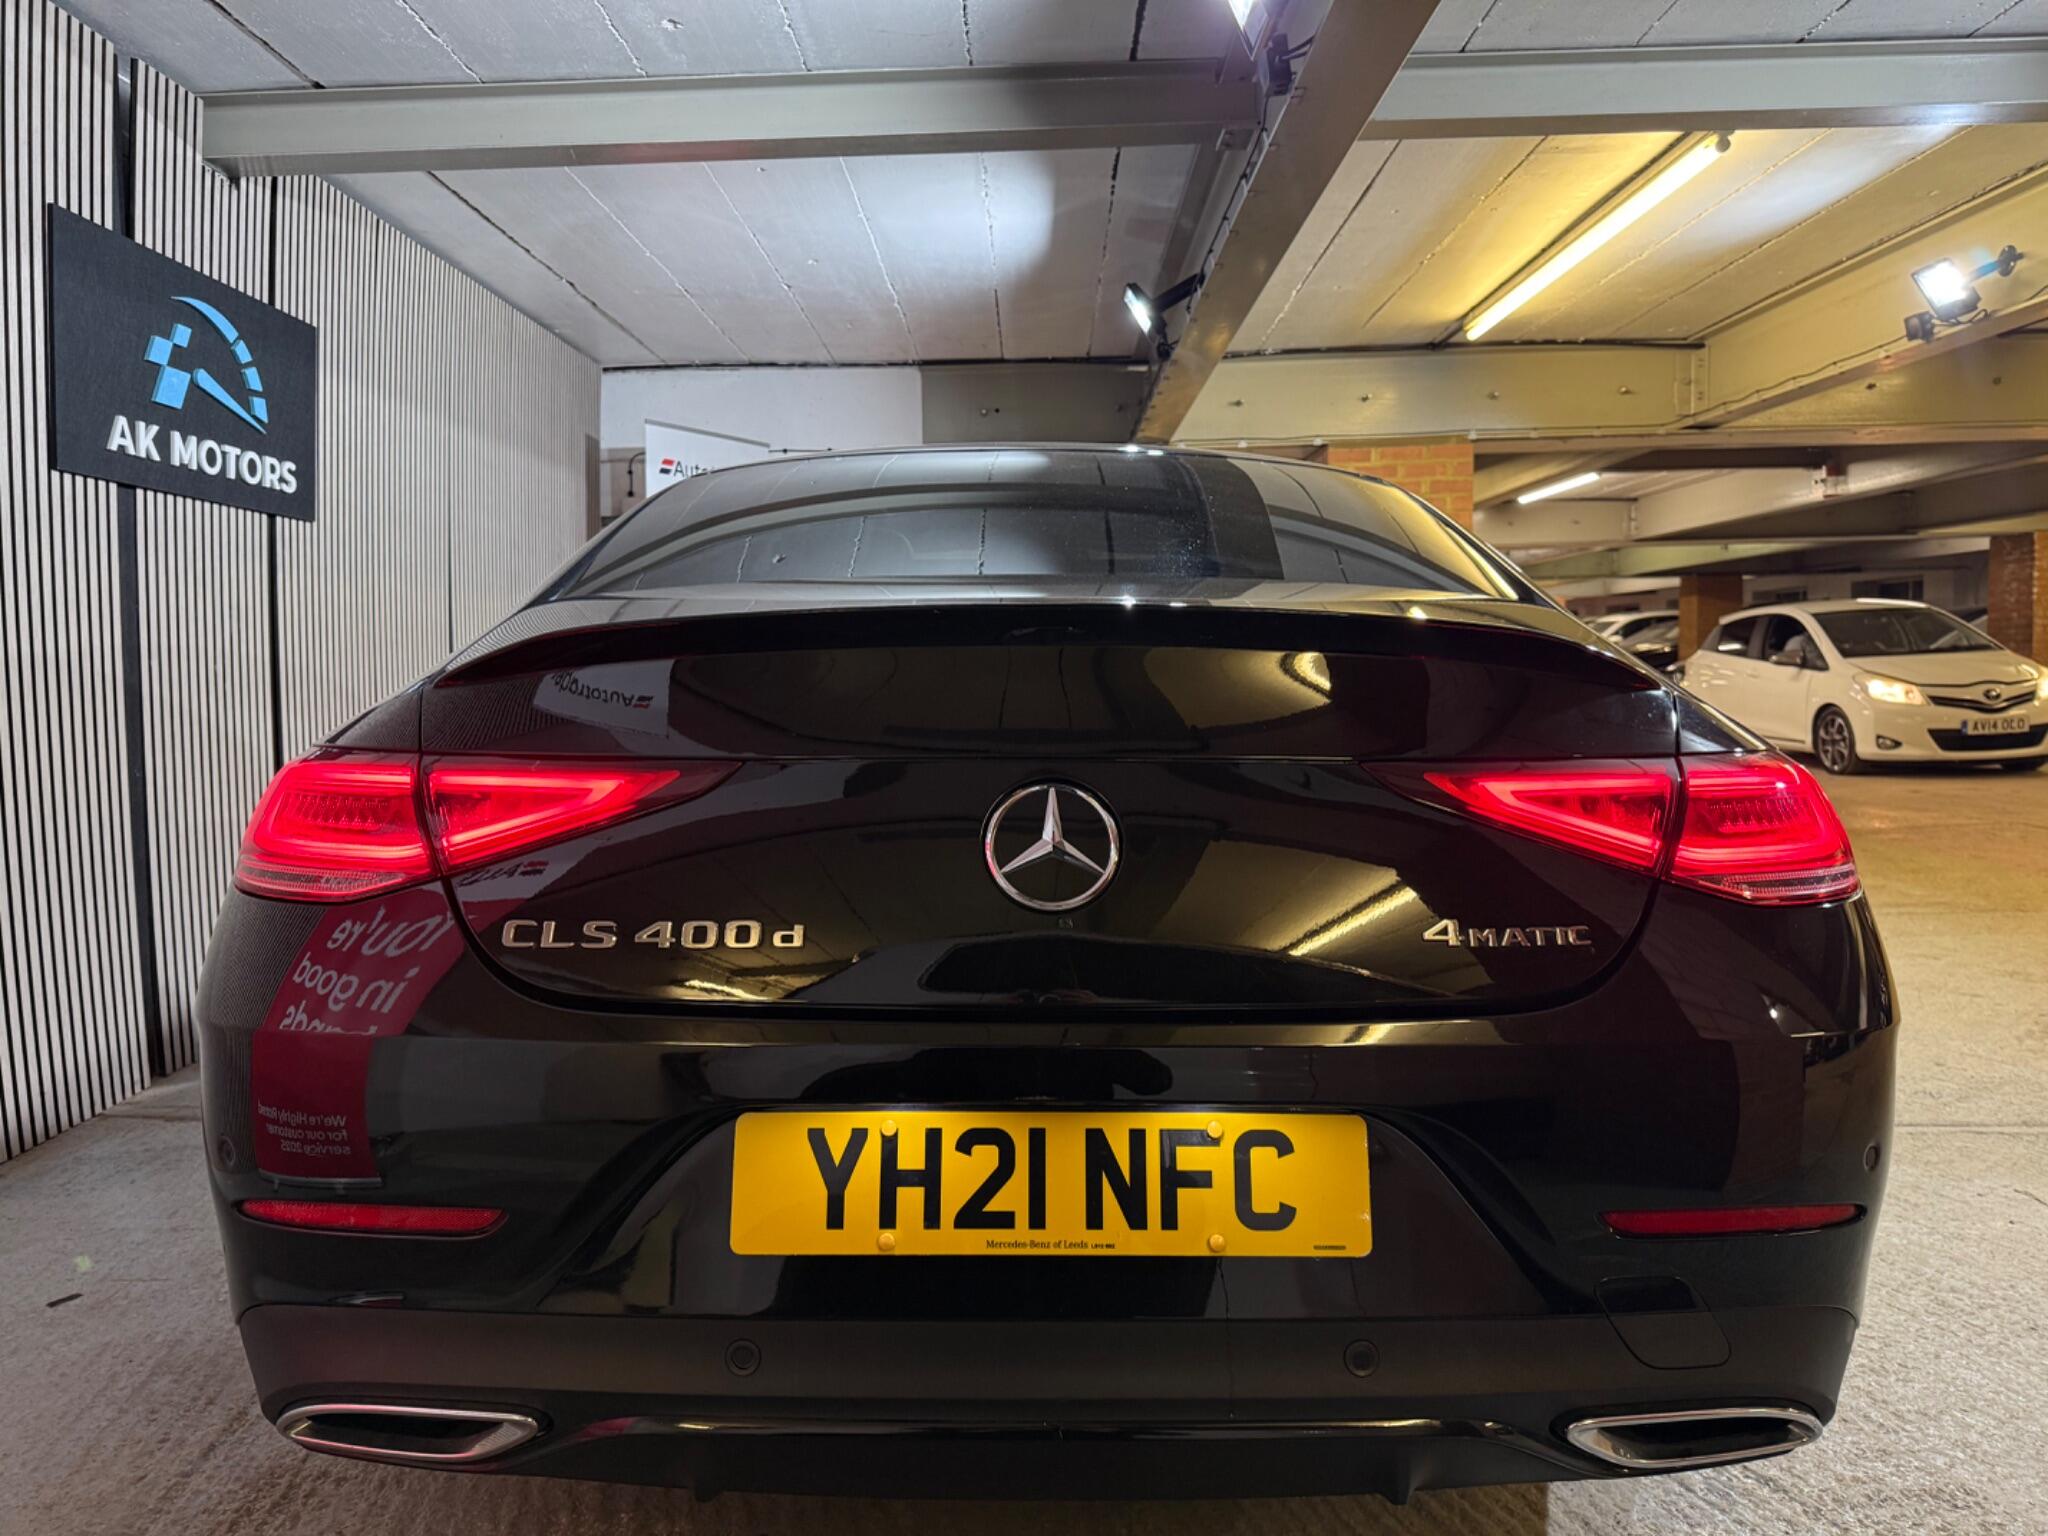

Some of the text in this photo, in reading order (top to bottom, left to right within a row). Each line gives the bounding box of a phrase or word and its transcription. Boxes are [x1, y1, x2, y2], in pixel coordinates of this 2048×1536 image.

[106, 415, 297, 493] AK MOTORS
[501, 919, 618, 949] CLS
[806, 1127, 1297, 1232] YH21 NFC
[986, 1239, 1051, 1249] Mercedes-Benz
[1053, 1239, 1062, 1249] of
[1063, 1239, 1088, 1249] Leeds
